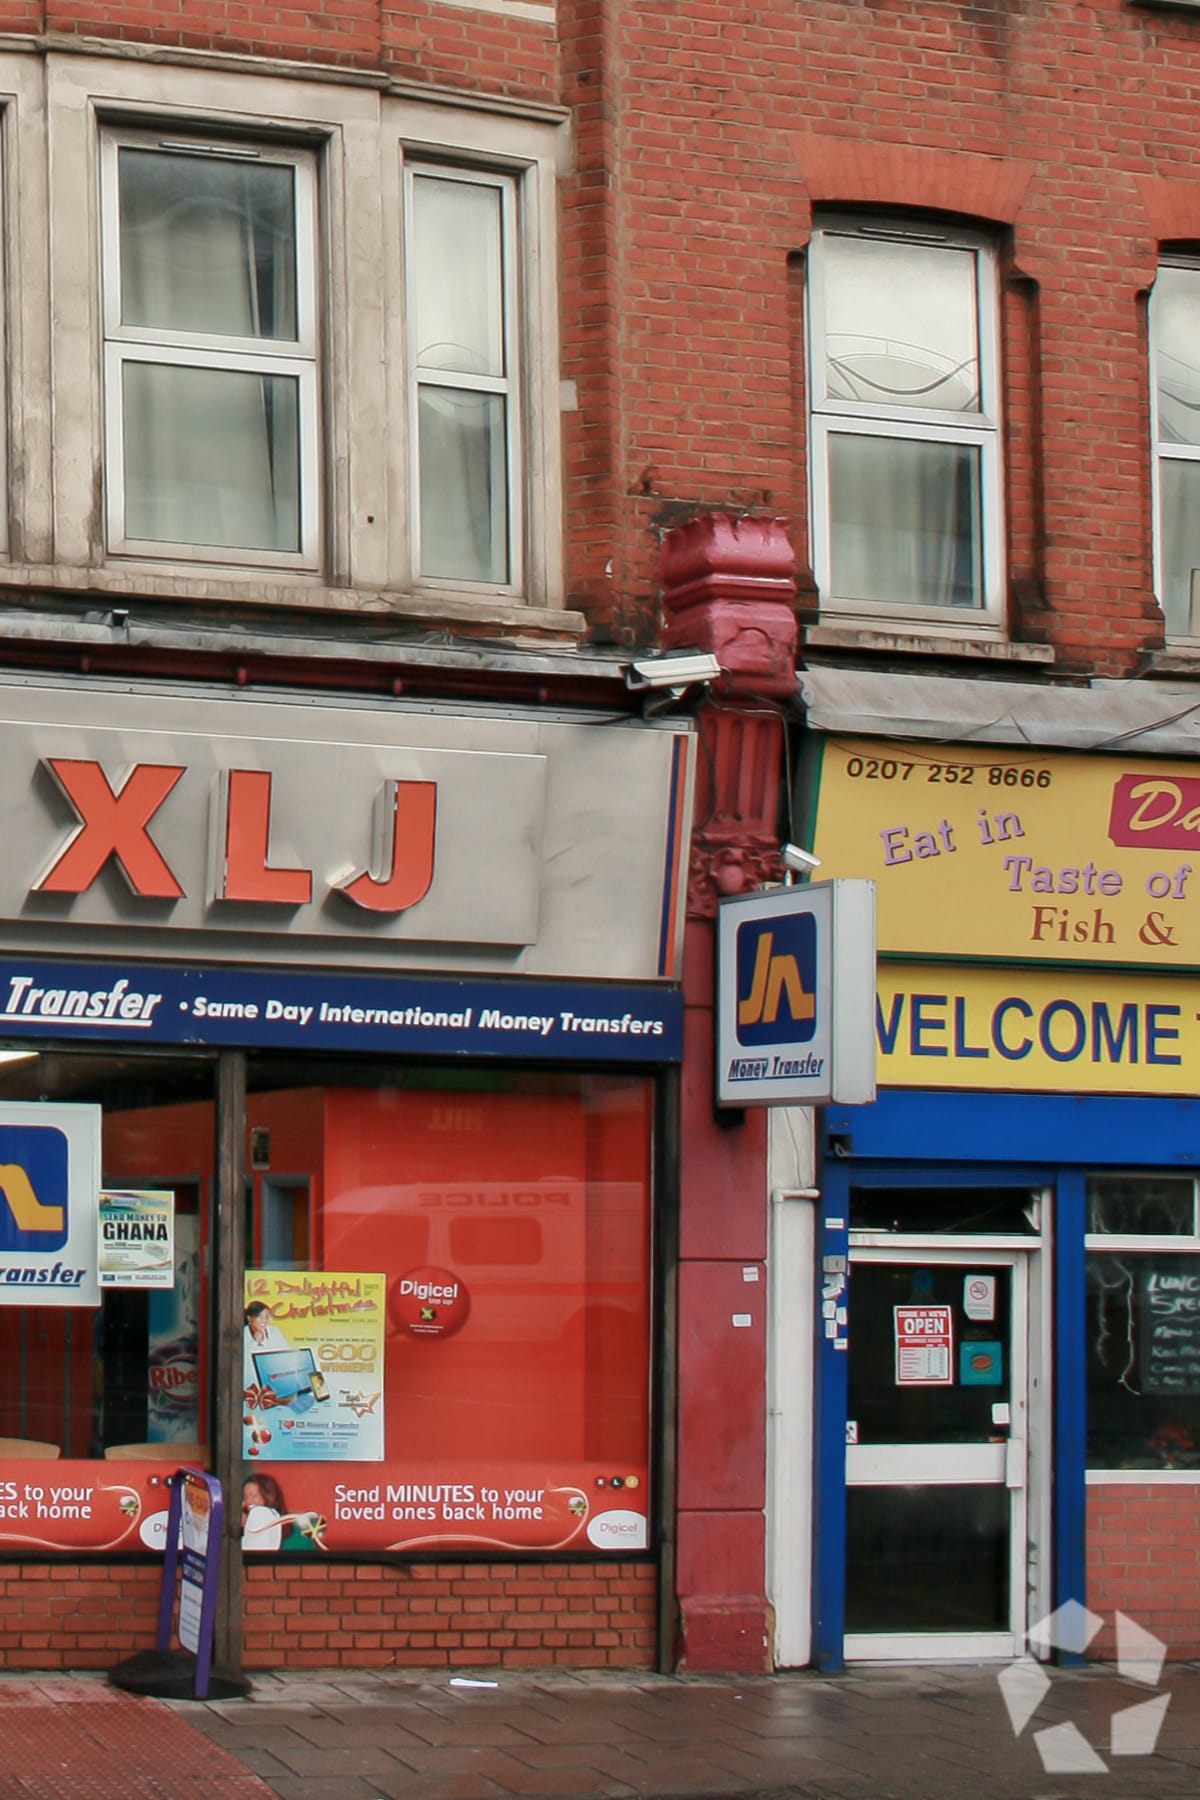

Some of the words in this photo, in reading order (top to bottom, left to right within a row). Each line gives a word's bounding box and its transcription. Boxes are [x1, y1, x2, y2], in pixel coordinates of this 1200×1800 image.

[846, 758, 914, 781] 0207
[928, 765, 974, 785] 252
[988, 768, 1051, 788] 8666
[878, 819, 956, 866] Eat
[976, 807, 1025, 845] in
[1003, 855, 1122, 896] Taste
[1145, 864, 1191, 899] of
[1030, 906, 1117, 944] Fish
[1139, 911, 1179, 946] &
[6, 977, 161, 1019] Transfer
[192, 997, 258, 1018] Same
[265, 1000, 313, 1025] Day
[319, 1003, 472, 1028] International
[478, 1009, 554, 1035] Money
[560, 1013, 664, 1035] Transfers
[728, 1059, 769, 1080] Money
[772, 1052, 824, 1075] Transfer
[103, 1222, 168, 1241] GHANA
[247, 1279, 270, 1297] 12
[400, 1280, 458, 1299] Digicel
[904, 1318, 944, 1334] OPEN
[318, 1343, 377, 1361] 600
[24, 1485, 44, 1500] to
[50, 1487, 93, 1504] your
[334, 1485, 379, 1502] Send
[386, 1485, 473, 1503] MINUTES
[480, 1487, 499, 1502] to
[504, 1489, 544, 1505] your
[36, 1502, 92, 1519] home
[335, 1503, 385, 1520] loved
[392, 1505, 436, 1520] ones
[442, 1503, 485, 1520] back
[492, 1503, 543, 1520] home
[600, 1523, 637, 1534] Digicel
